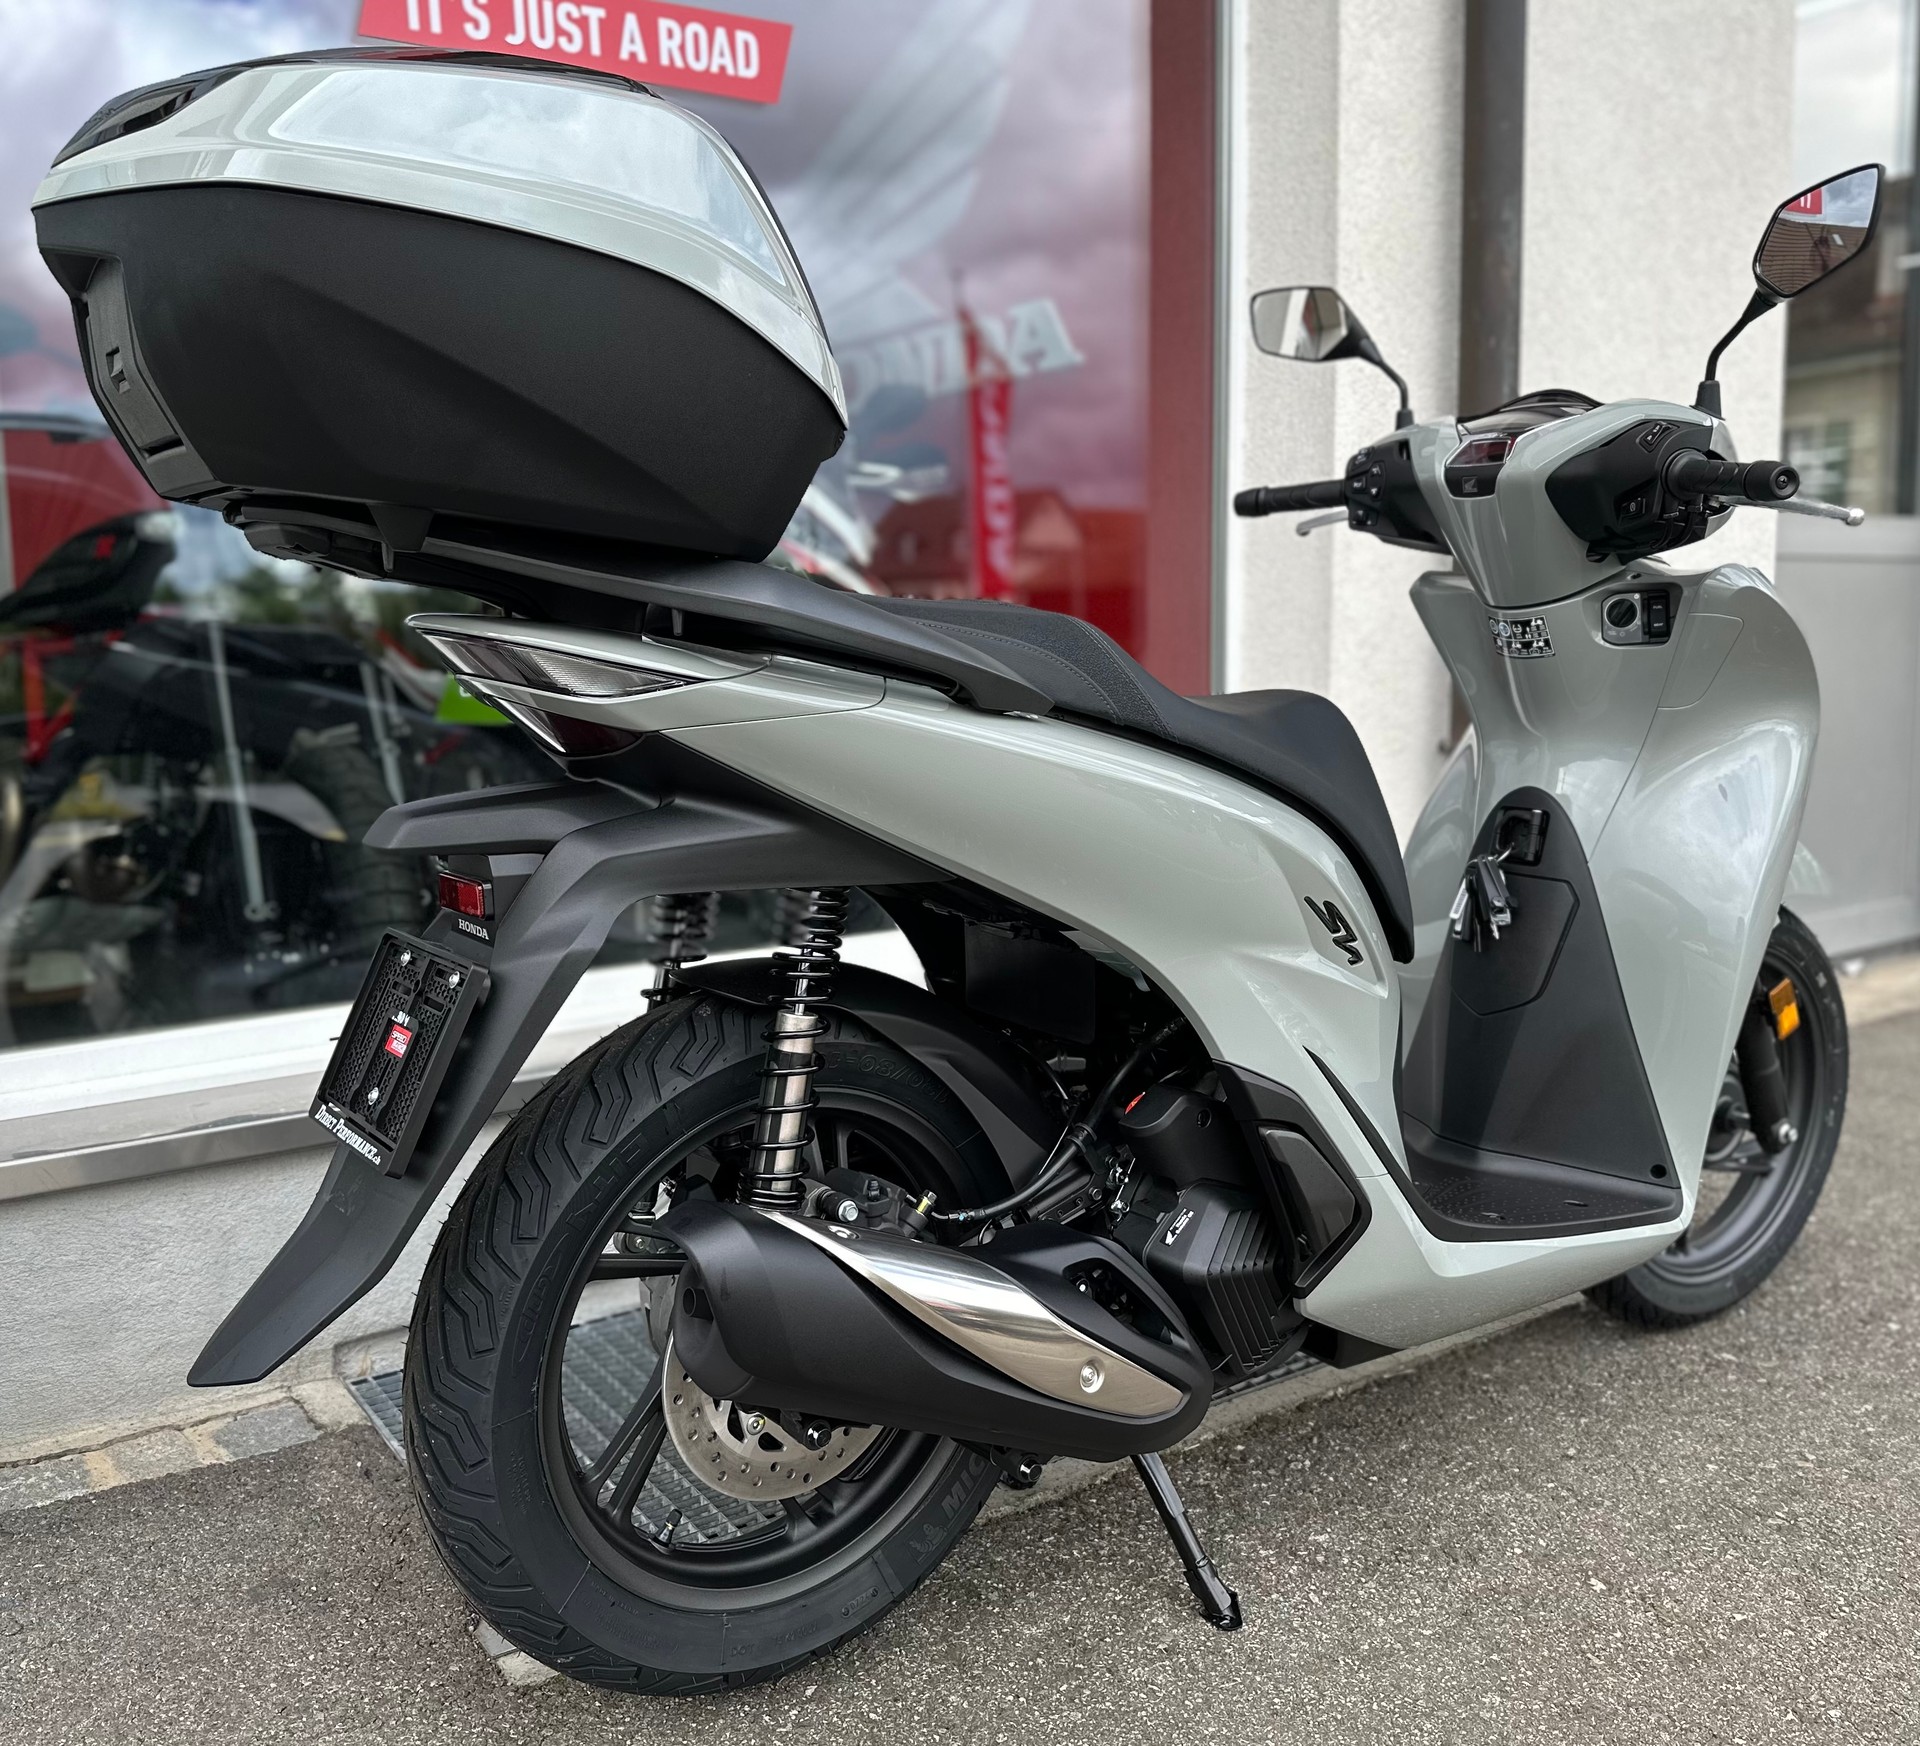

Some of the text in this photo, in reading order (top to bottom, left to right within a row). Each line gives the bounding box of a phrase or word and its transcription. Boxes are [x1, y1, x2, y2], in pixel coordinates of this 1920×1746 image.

[406, 0, 761, 79] ITS JUST A ROAD
[458, 919, 490, 940] HONDA
